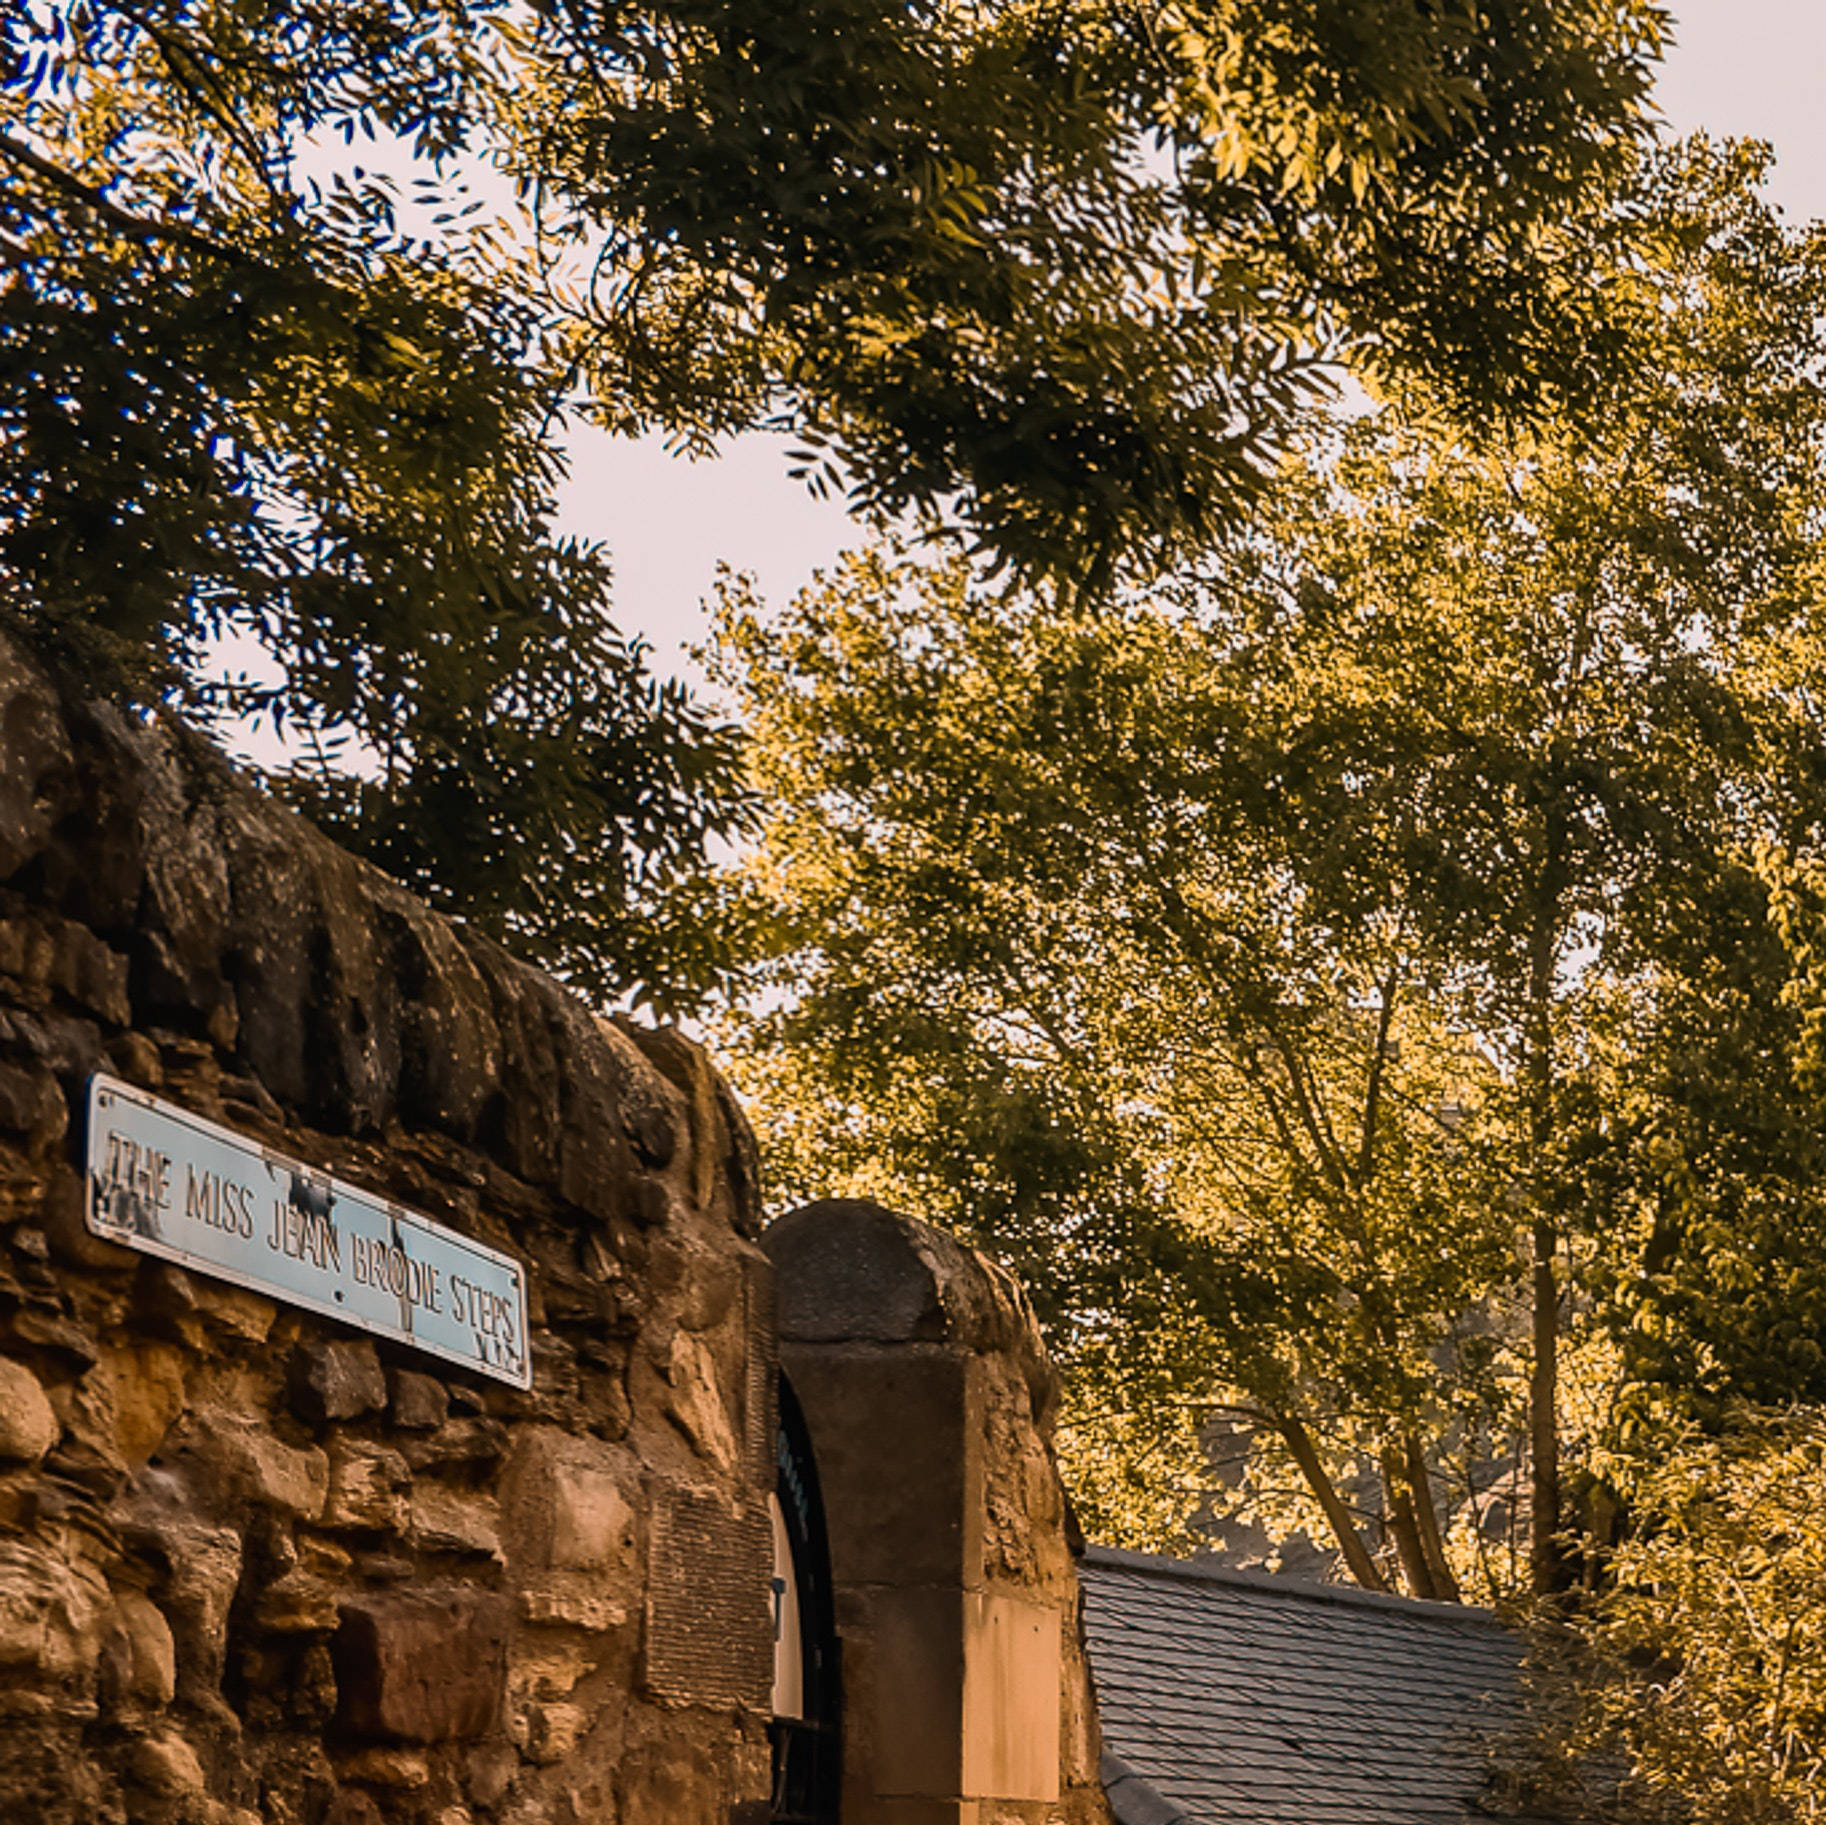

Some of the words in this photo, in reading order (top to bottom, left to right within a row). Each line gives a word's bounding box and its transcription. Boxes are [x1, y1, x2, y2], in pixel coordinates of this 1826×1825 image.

[108, 1130, 172, 1210] THE
[186, 1162, 255, 1239] MISS
[267, 1199, 341, 1274] JEAN
[351, 1232, 443, 1314] BRODIE
[451, 1274, 515, 1343] STEPS
